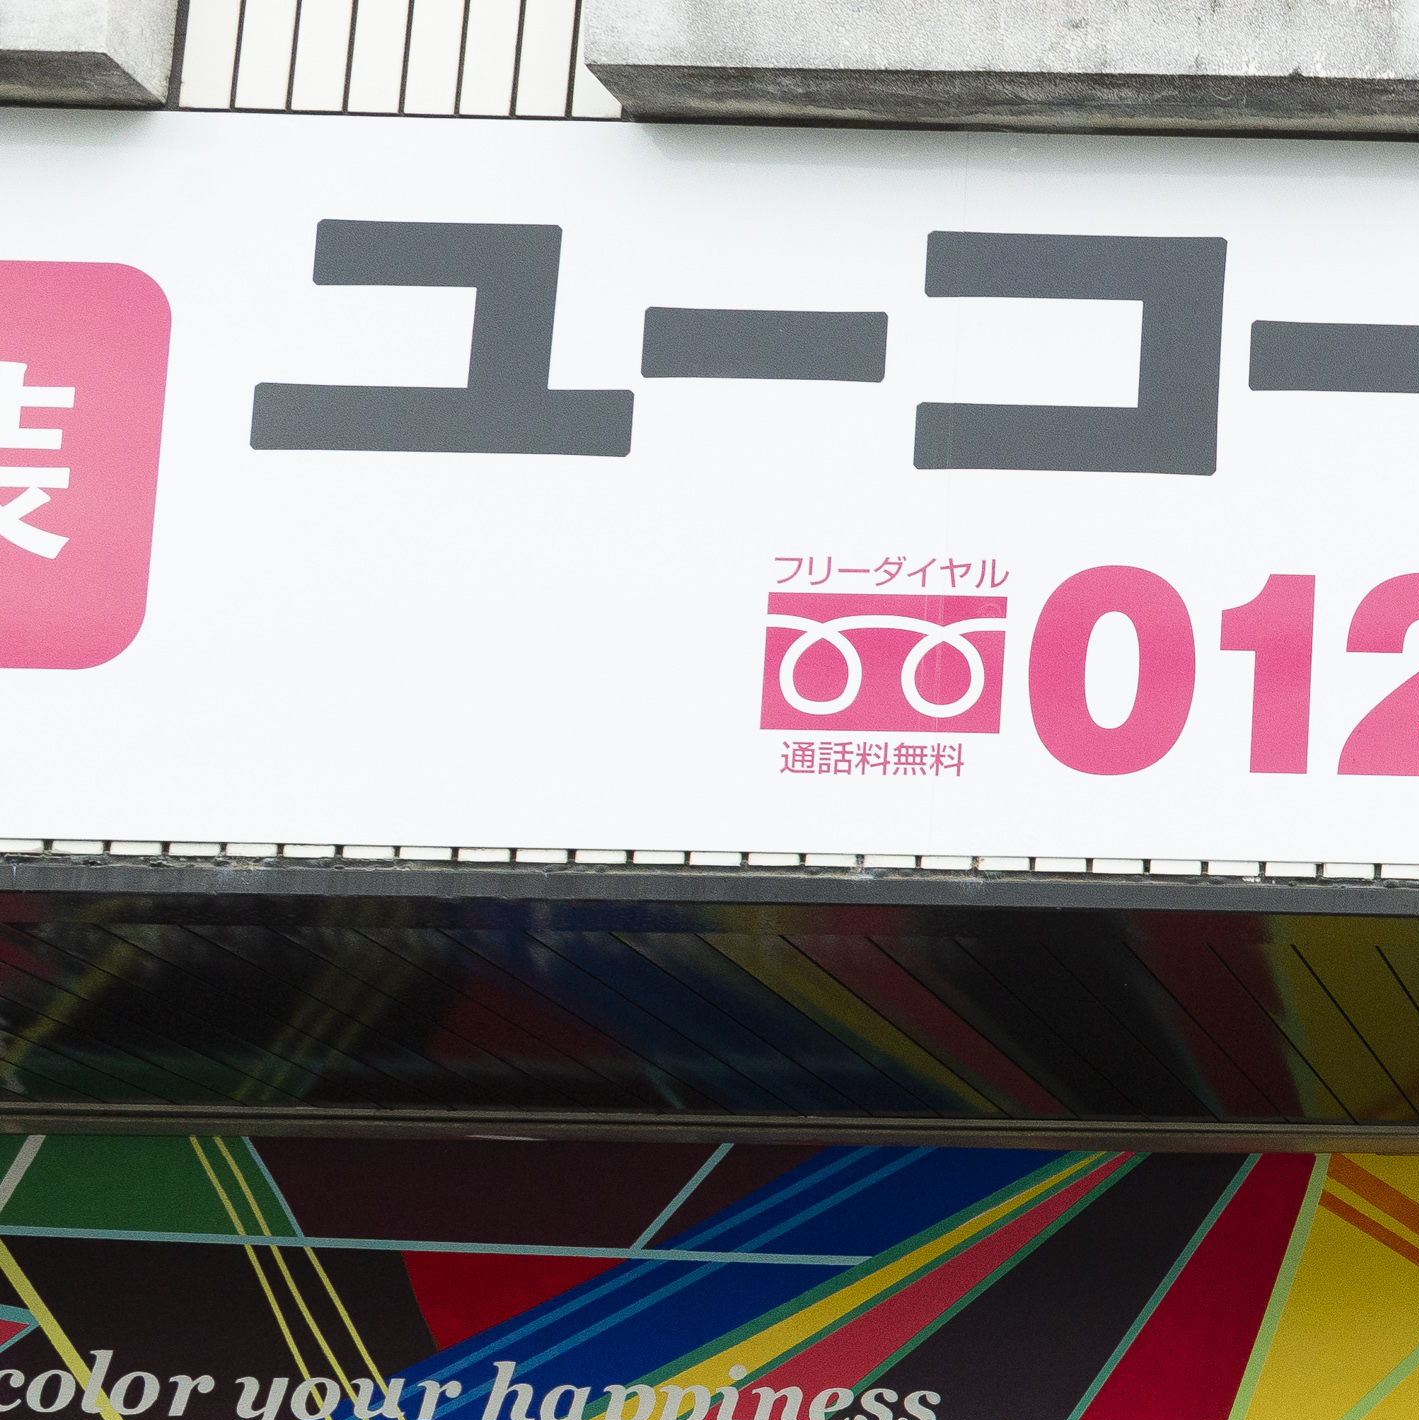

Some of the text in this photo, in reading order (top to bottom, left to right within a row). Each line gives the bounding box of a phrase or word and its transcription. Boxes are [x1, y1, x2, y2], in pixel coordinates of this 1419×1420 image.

[774, 556, 1010, 589] フリーダイヤル
[779, 741, 965, 777] 通話料無料
